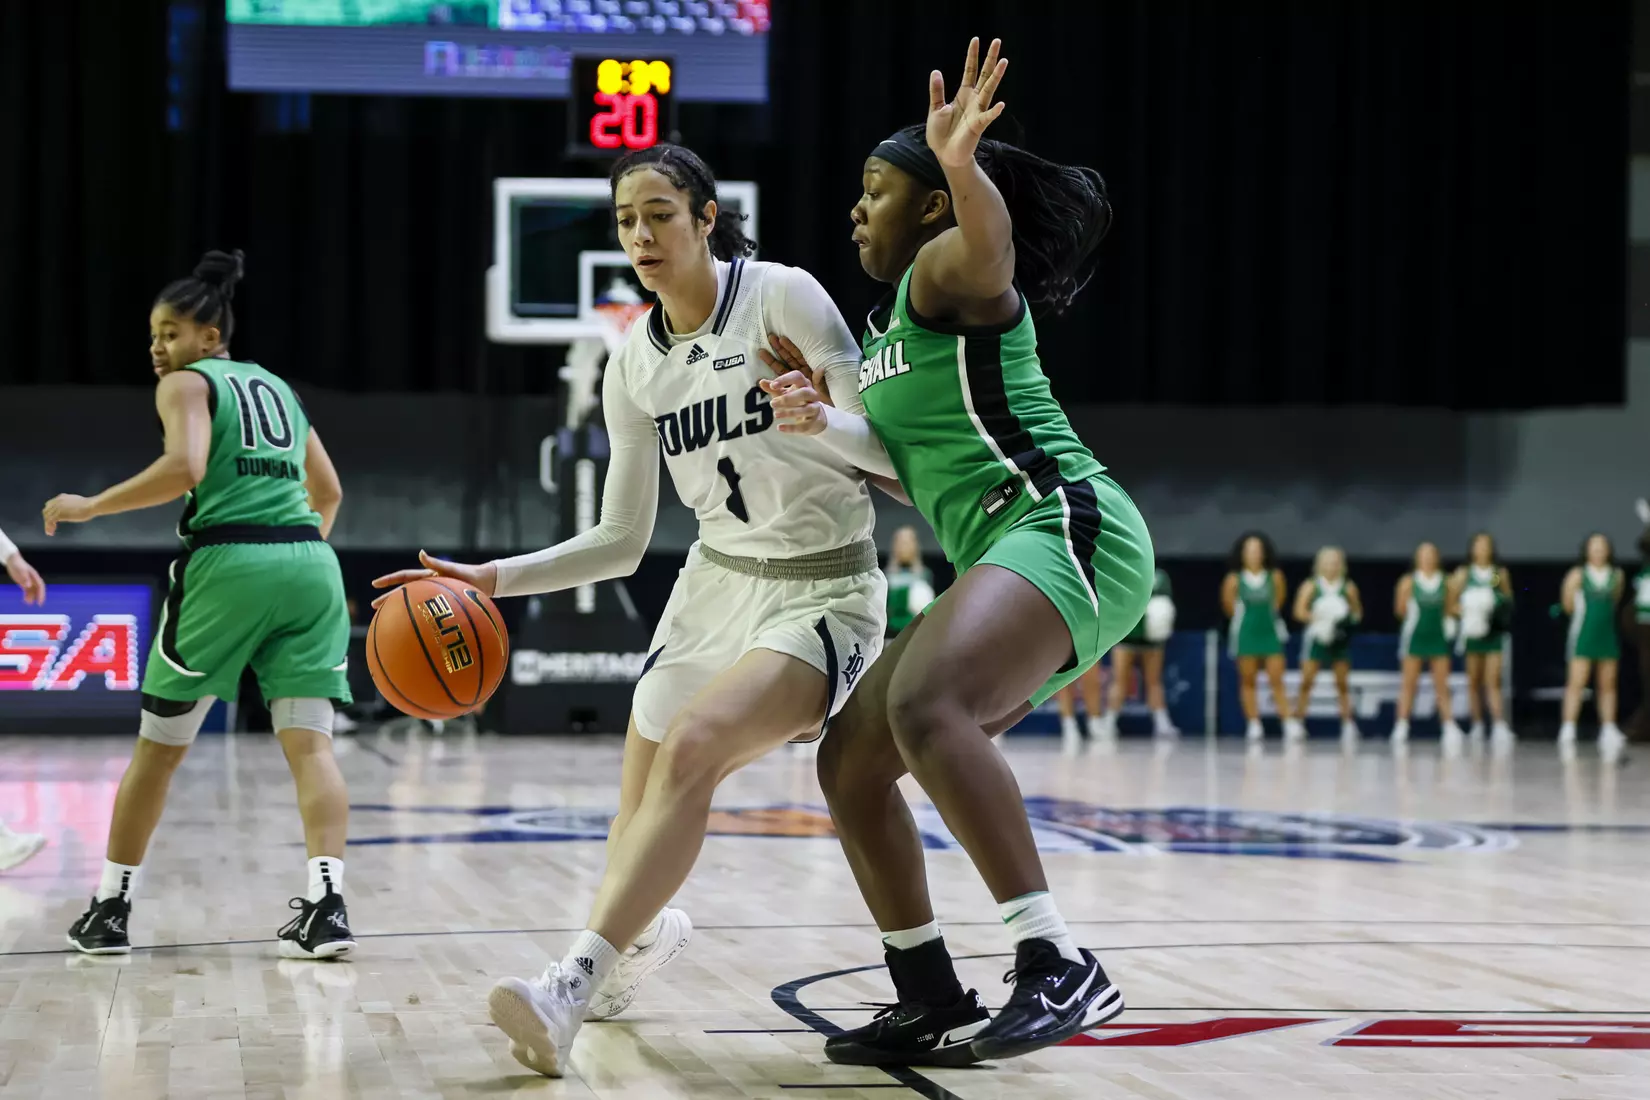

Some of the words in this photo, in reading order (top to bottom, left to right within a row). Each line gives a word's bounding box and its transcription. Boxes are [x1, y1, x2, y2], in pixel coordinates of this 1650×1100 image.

[590, 91, 658, 149] 20
[224, 373, 295, 450] 10
[654, 387, 773, 457] OWLS
